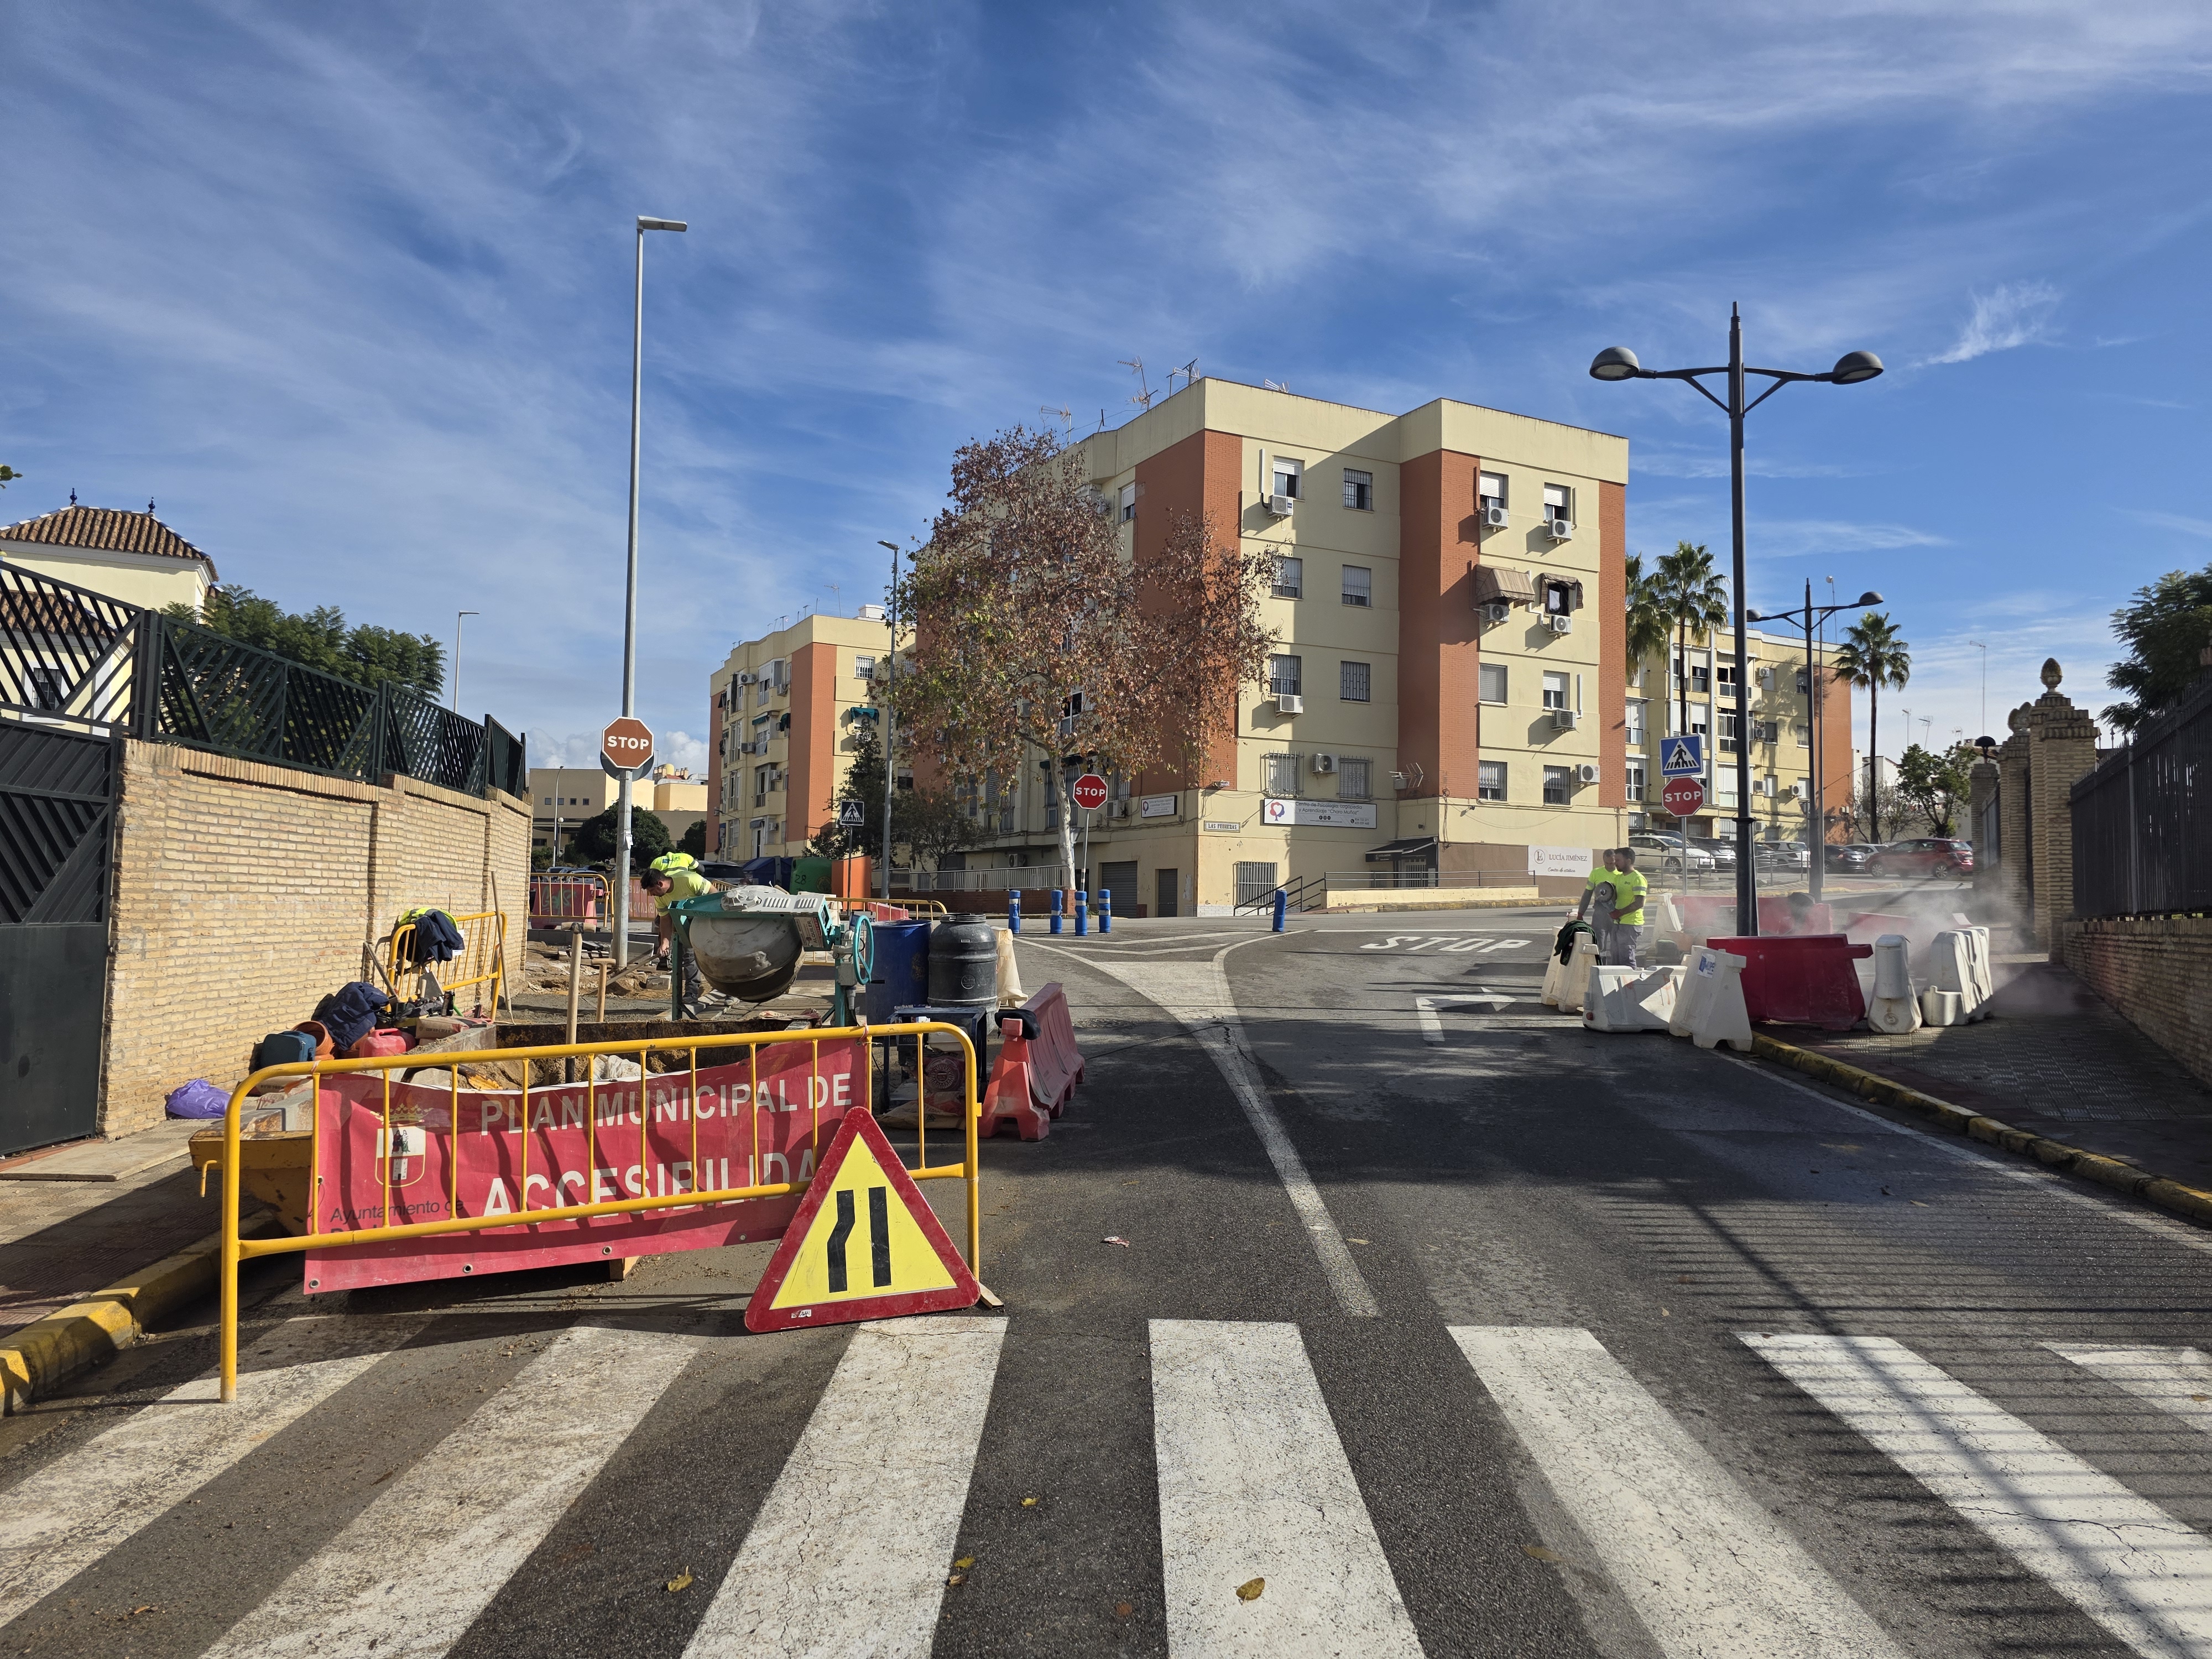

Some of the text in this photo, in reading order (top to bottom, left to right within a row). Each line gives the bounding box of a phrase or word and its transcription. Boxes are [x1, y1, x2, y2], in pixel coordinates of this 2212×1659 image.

[607, 735, 649, 750] STOP
[1076, 787, 1105, 797] STOP
[1665, 791, 1702, 802] STOP
[794, 874, 807, 885] 28
[807, 920, 818, 943] ALQUILER
[1359, 936, 1533, 953] STOP
[481, 1073, 852, 1136] PLAN MUNICIPAL DE
[482, 1149, 816, 1227] ACCESIBILIDA
[330, 1199, 440, 1225] Ayuntamiento
